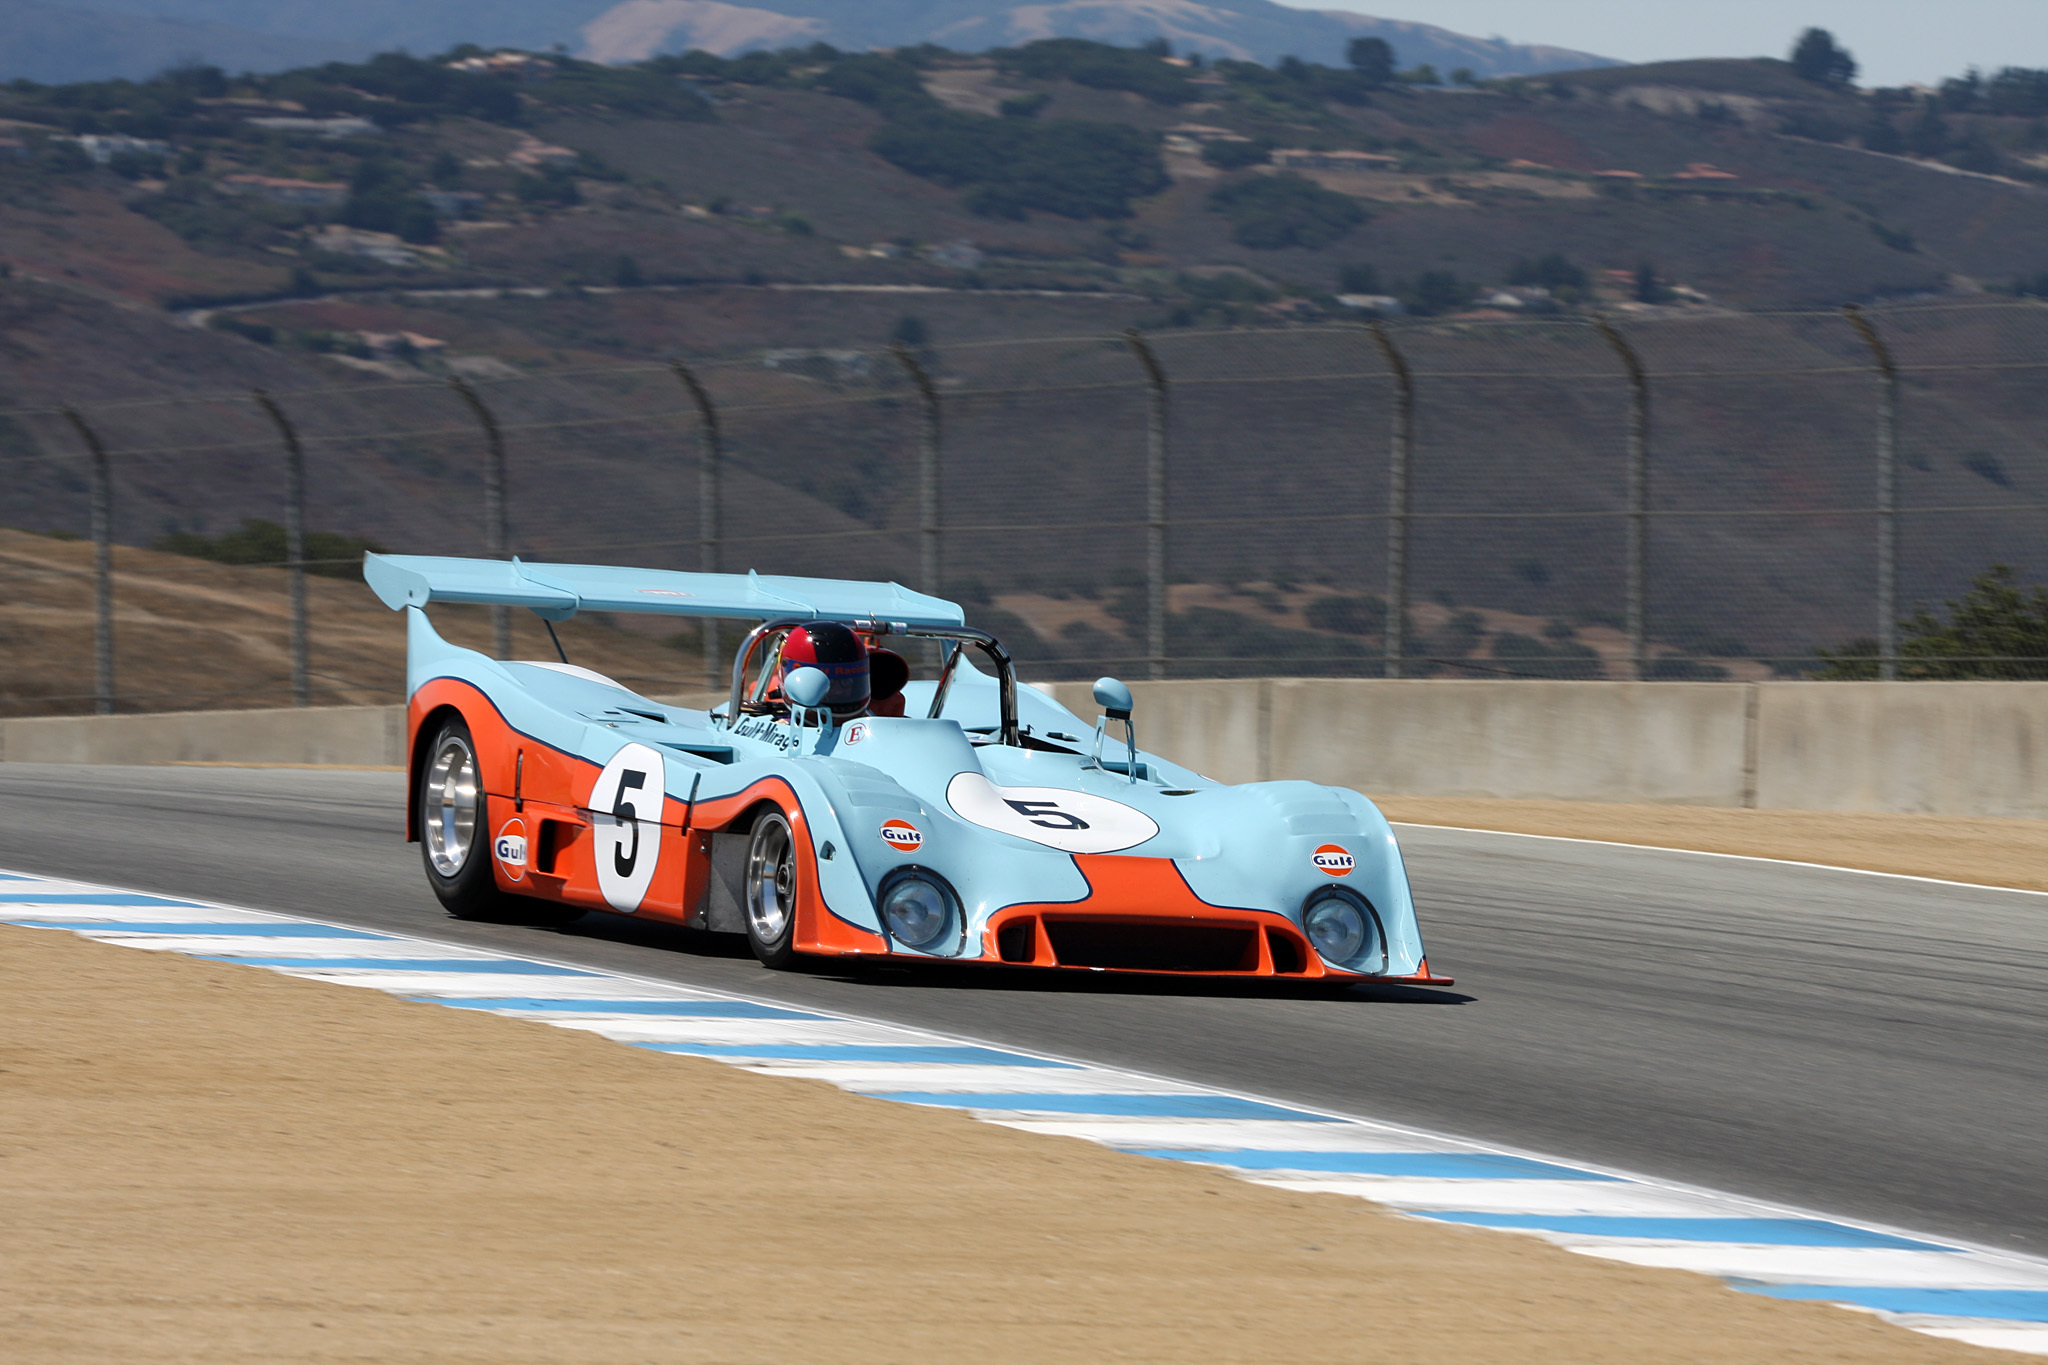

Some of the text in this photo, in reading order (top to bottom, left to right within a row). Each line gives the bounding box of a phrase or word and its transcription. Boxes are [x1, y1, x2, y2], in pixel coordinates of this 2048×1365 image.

[849, 726, 863, 743] E
[1001, 797, 1091, 831] 5
[612, 768, 647, 879] 5
[882, 828, 921, 842] Gulf
[1313, 855, 1353, 866] Gulf
